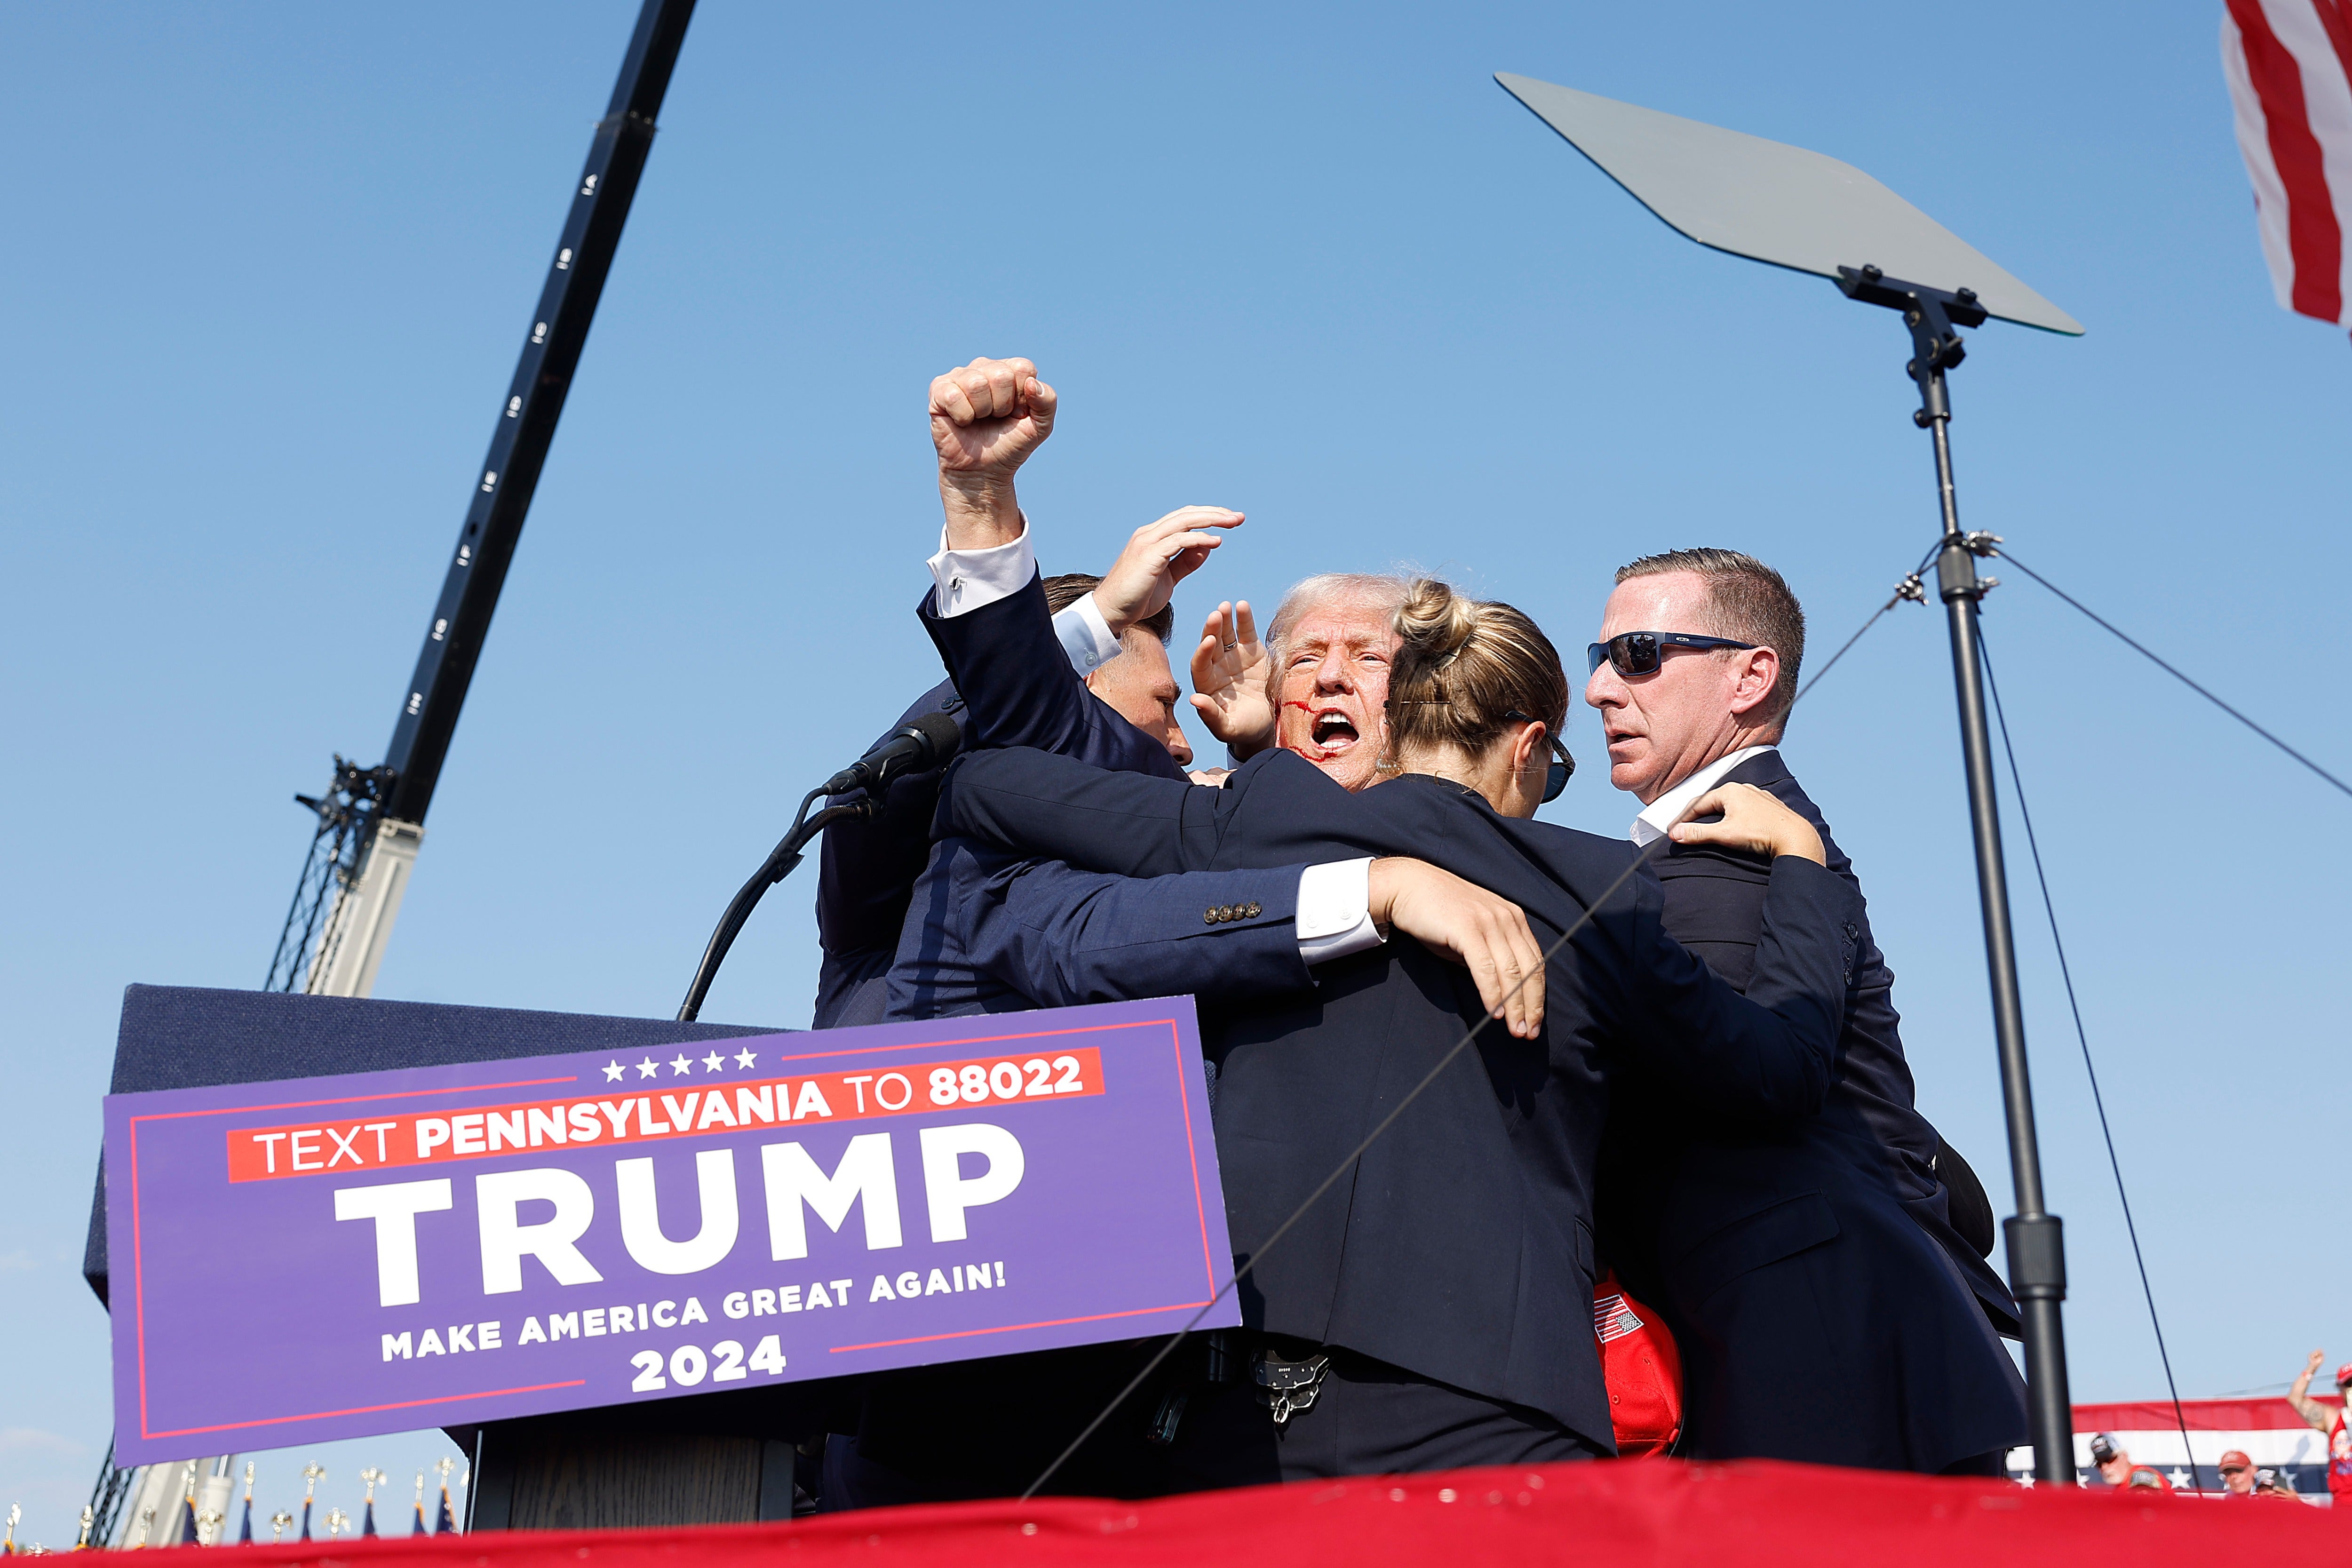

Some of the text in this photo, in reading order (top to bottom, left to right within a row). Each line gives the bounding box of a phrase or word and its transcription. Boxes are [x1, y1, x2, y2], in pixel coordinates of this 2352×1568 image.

[253, 1056, 1082, 1173] TEXT PENNSYLVANIA TO 88022
[334, 1123, 1025, 1307] TRUMP
[381, 1261, 1006, 1361] MAKE AMERICA GREAT AGAIN!
[630, 1335, 787, 1393] 2024
